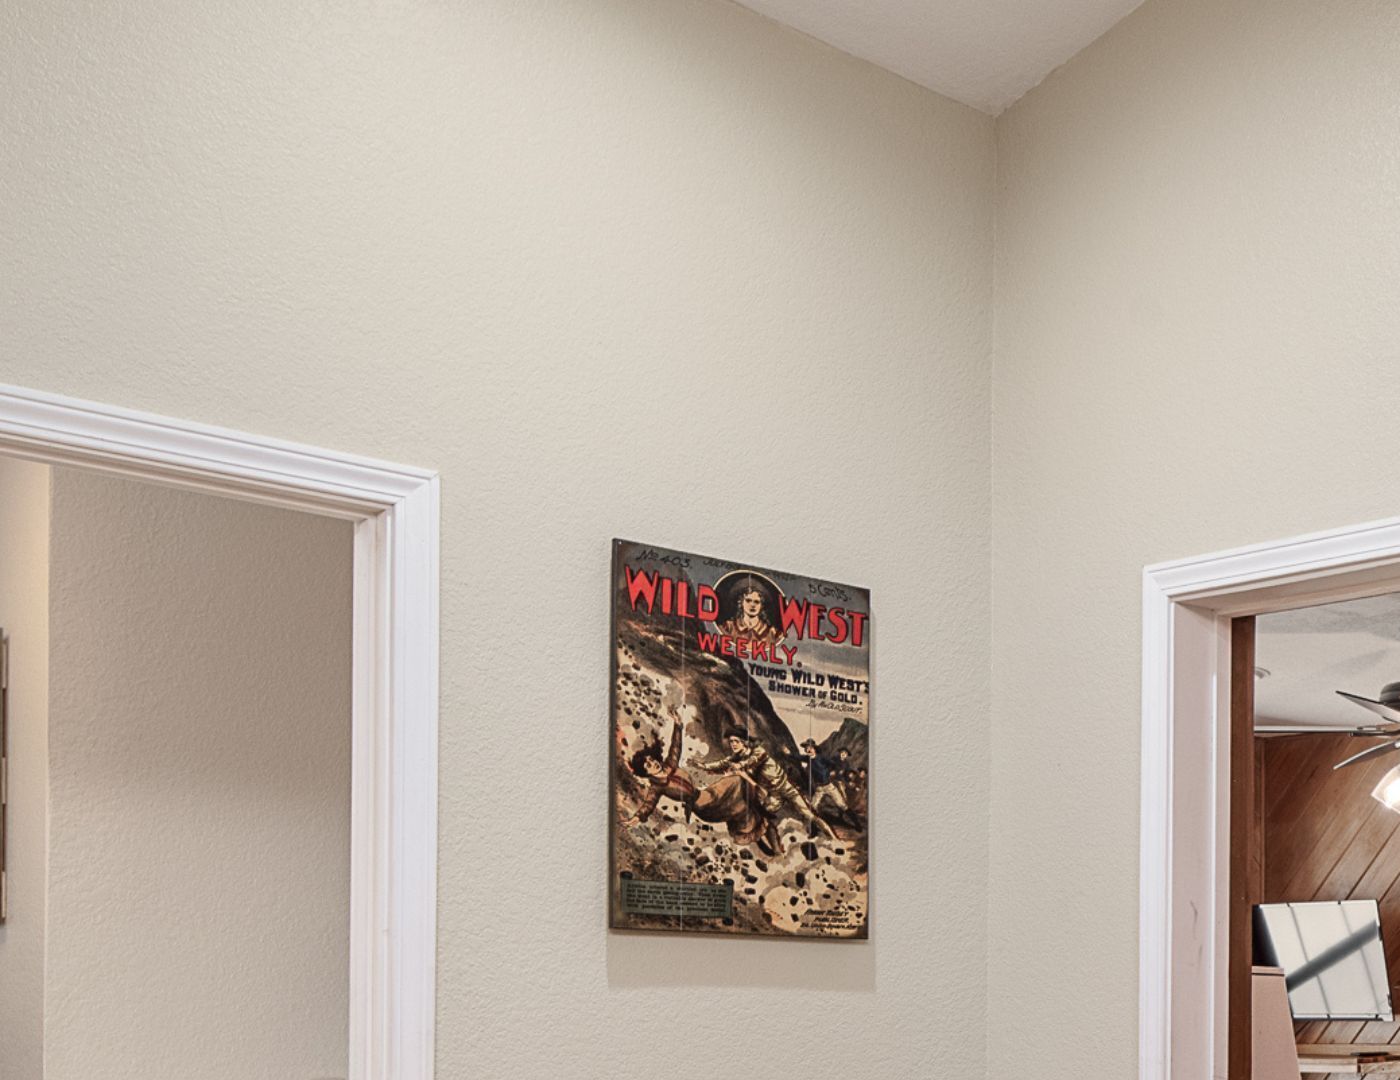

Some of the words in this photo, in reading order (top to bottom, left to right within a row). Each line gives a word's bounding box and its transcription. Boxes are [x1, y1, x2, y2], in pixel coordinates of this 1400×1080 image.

[624, 564, 720, 622] WILD
[778, 594, 869, 647] WEST
[748, 663, 787, 681] YOUNG
[791, 668, 826, 687] WILD
[768, 681, 816, 698] SHOWER
